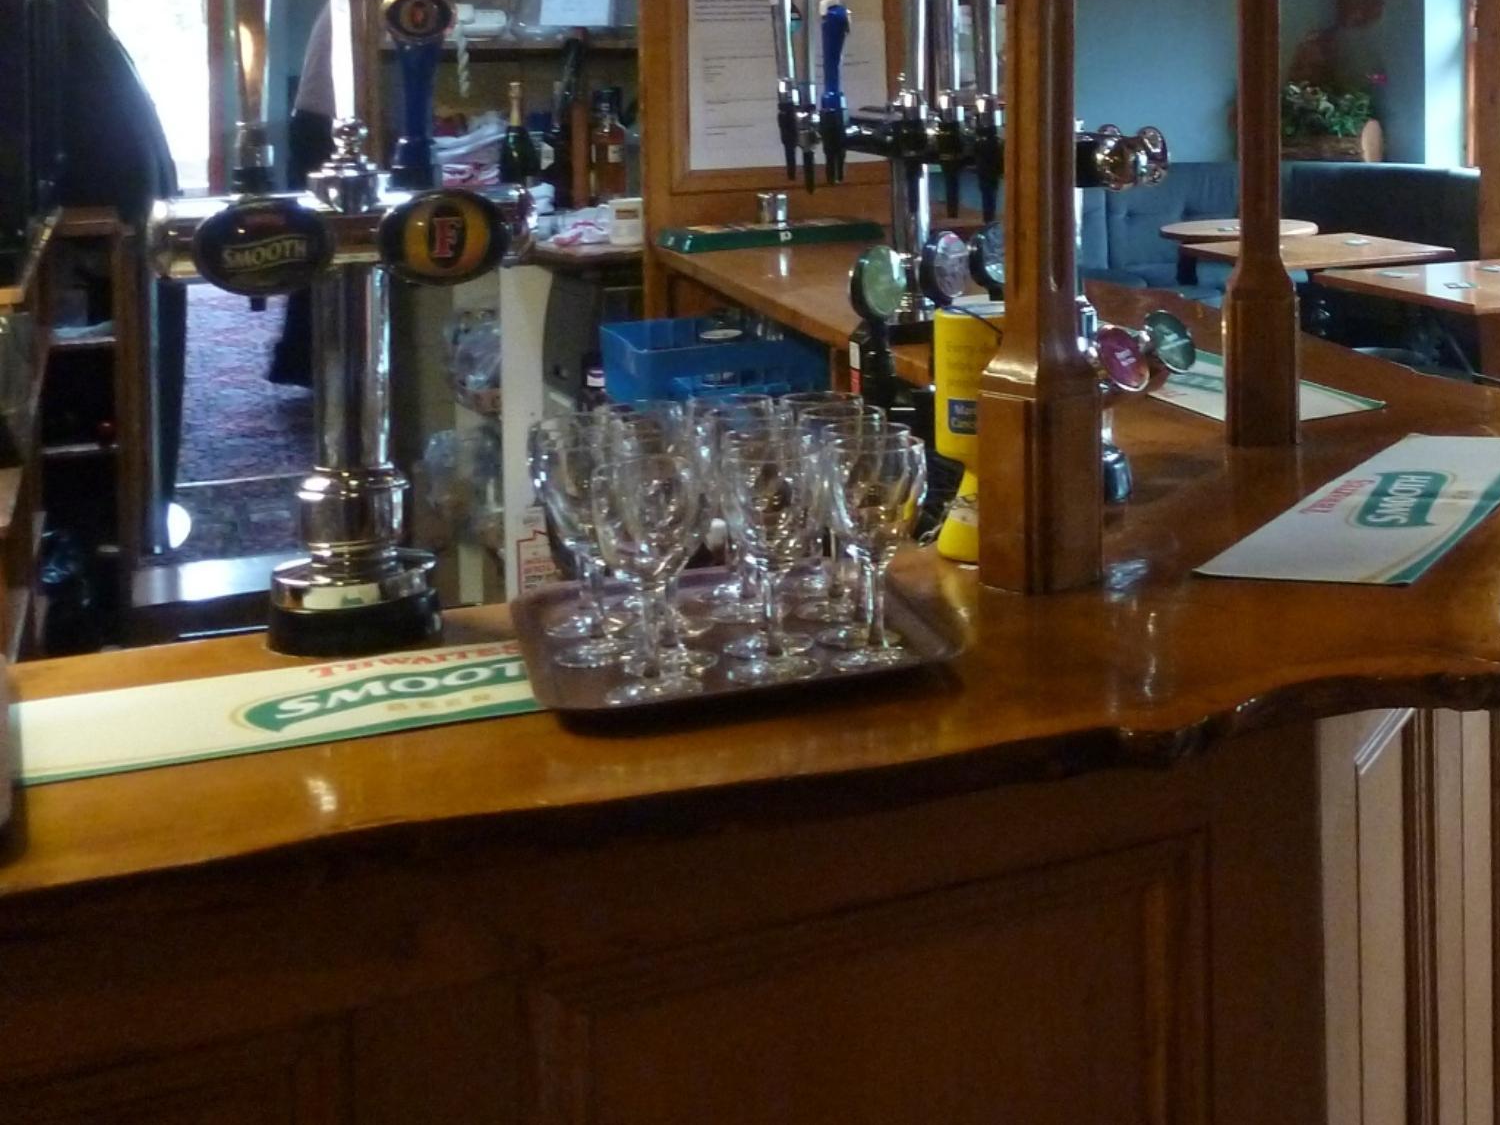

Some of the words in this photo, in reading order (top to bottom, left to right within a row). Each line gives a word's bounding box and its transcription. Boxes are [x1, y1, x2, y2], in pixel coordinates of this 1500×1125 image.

[221, 237, 308, 269] SMOOTH
[432, 215, 462, 259] F
[1365, 474, 1432, 524] SMOOTH
[274, 661, 526, 719] SMOOT
